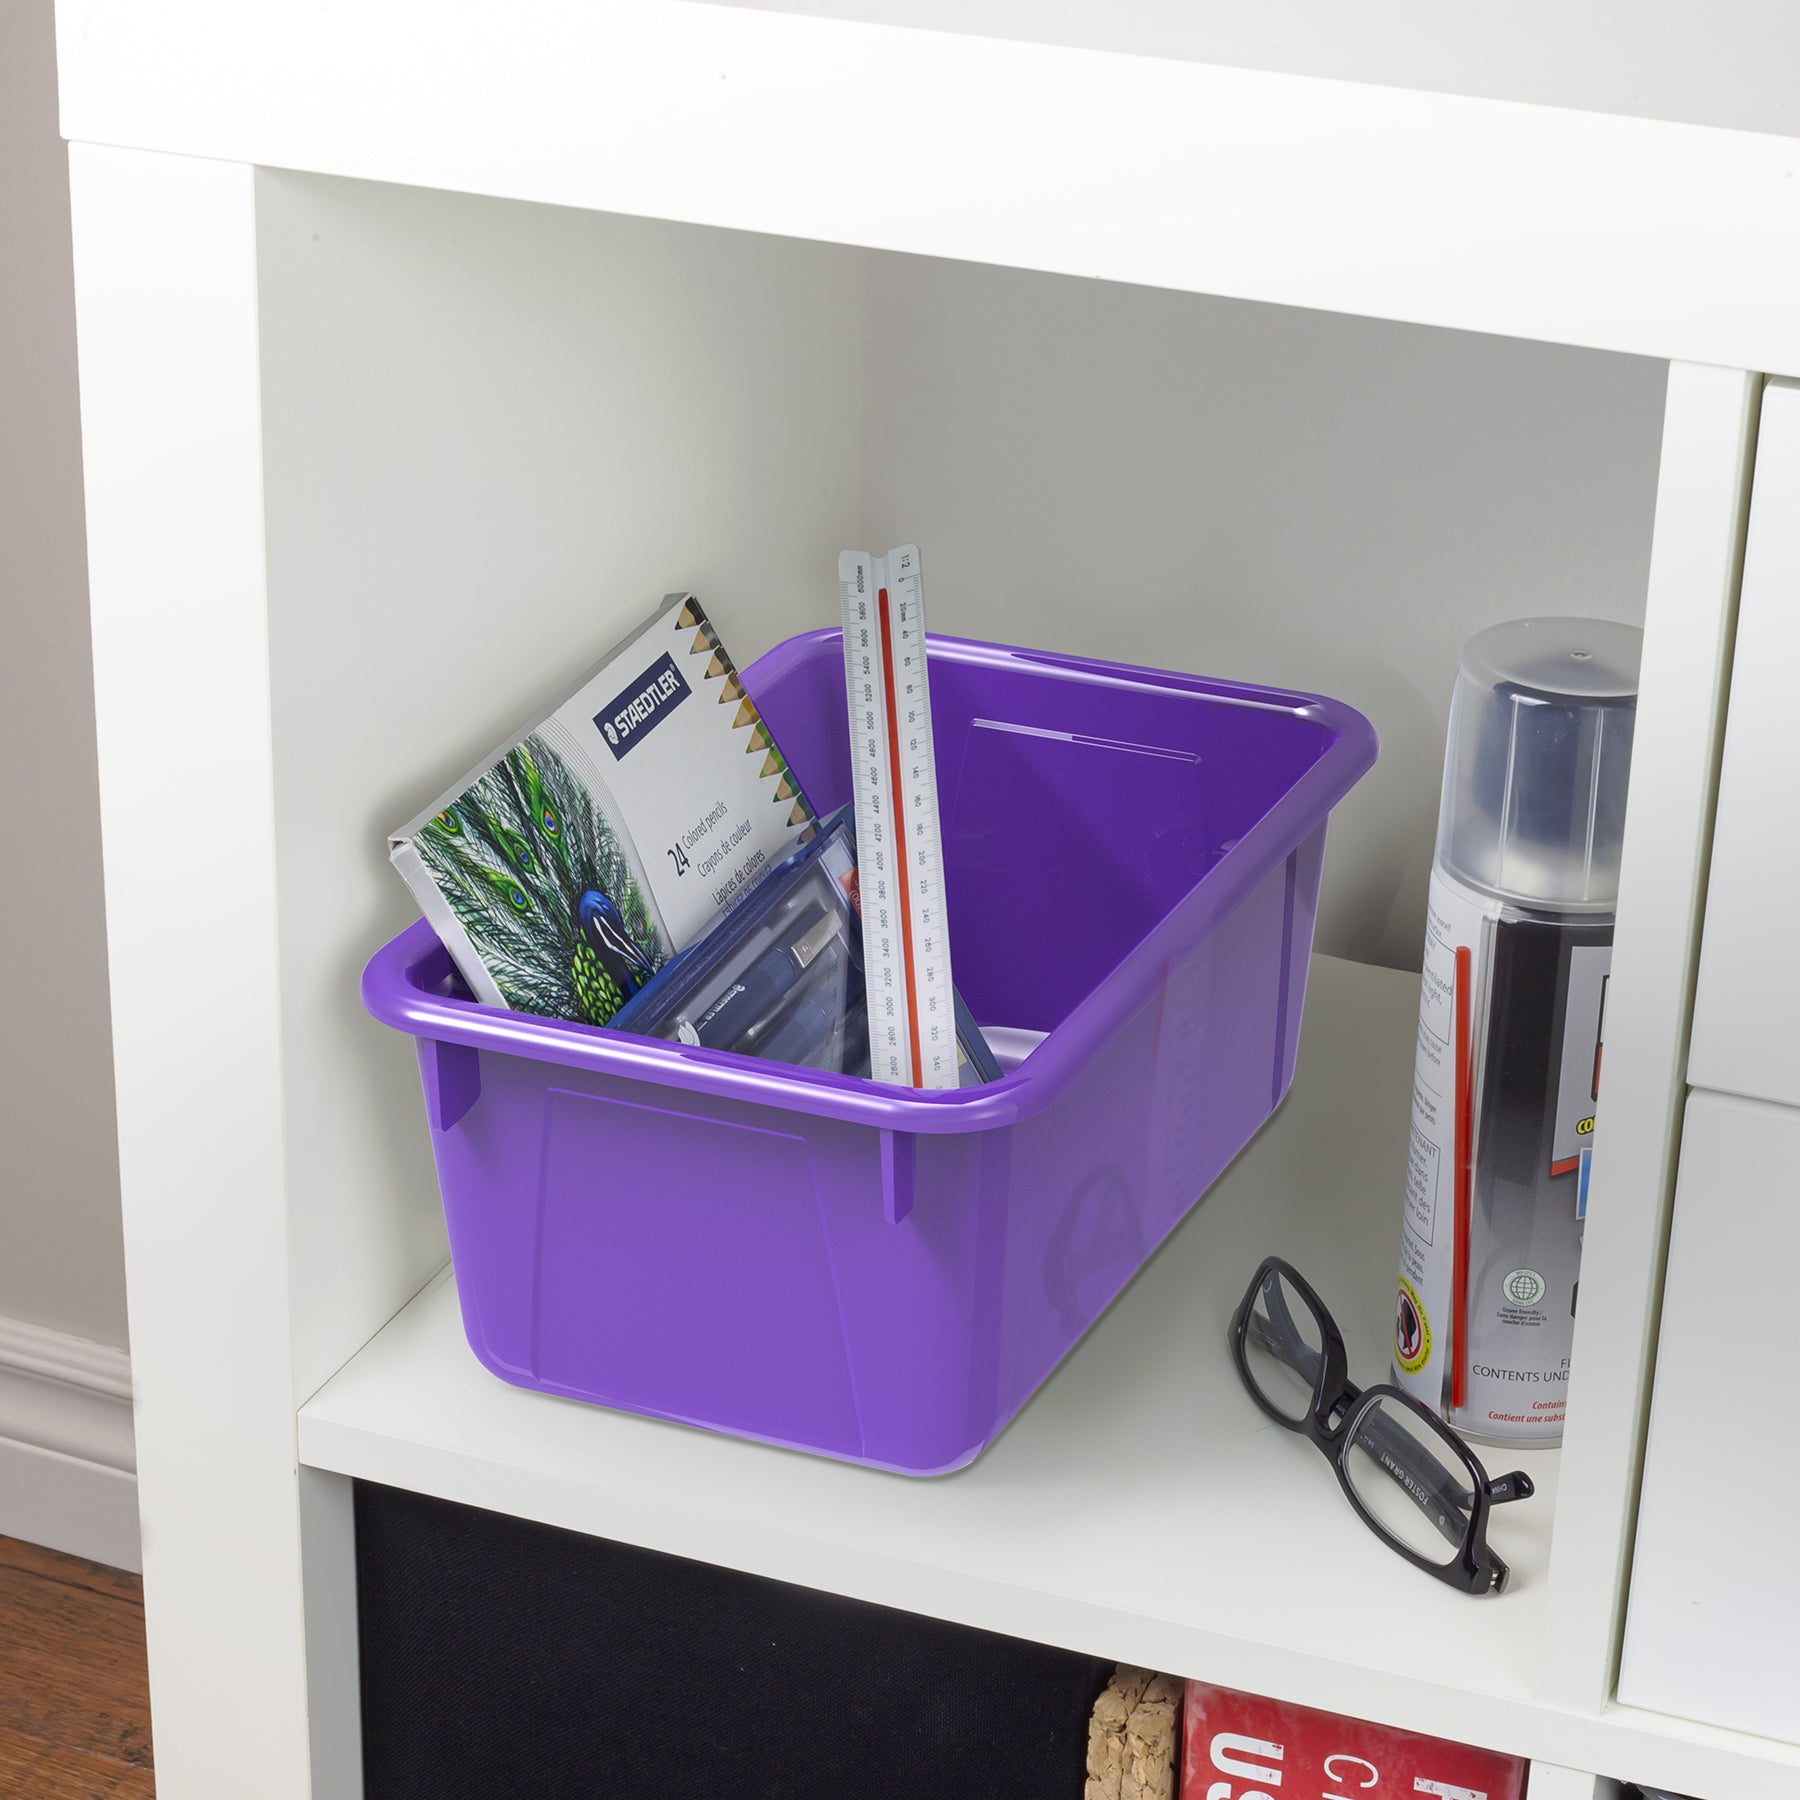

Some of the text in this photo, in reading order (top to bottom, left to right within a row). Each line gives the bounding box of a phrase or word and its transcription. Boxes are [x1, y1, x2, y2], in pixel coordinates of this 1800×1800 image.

[901, 554, 911, 569] 1:2
[858, 602, 866, 620] 5800
[860, 629, 868, 647] 5600
[902, 630, 909, 640] 40
[862, 656, 870, 675] 5400
[904, 657, 911, 667] 60
[864, 684, 872, 702] 5200
[906, 684, 913, 694] 80
[614, 669, 681, 738] STAEDTLER
[866, 711, 874, 730] 5000
[868, 738, 876, 758] 4800
[870, 766, 878, 786] 4600
[682, 801, 728, 849] Colored pencils
[916, 823, 924, 836] 180
[697, 819, 752, 877] Crayons de couleur
[667, 842, 691, 877] 24
[876, 852, 884, 871] 4000
[918, 851, 926, 866] 200
[712, 878, 737, 907] Lápices
[735, 869, 745, 884] de
[743, 849, 766, 875] colores
[920, 880, 928, 894] 220
[878, 880, 886, 900] 3800
[880, 909, 888, 929] 3600
[922, 908, 930, 923] 240
[882, 938, 890, 958] 3400
[924, 937, 932, 953] 260
[884, 967, 892, 987] 3200
[926, 966, 934, 982] 280
[705, 989, 738, 1021] STAEDTLER
[886, 996, 894, 1016] 3000
[928, 996, 937, 1012] 300
[888, 1026, 896, 1046] 2800
[931, 1026, 939, 1041] 320
[890, 1056, 898, 1076] 2600
[933, 1055, 941, 1071] 340
[1472, 1364, 1540, 1382] CONTENTS
[1488, 1411, 1525, 1422] Contient
[1380, 1452, 1429, 1505] FOSTER GRANT
[1322, 1754, 1379, 1800] C
